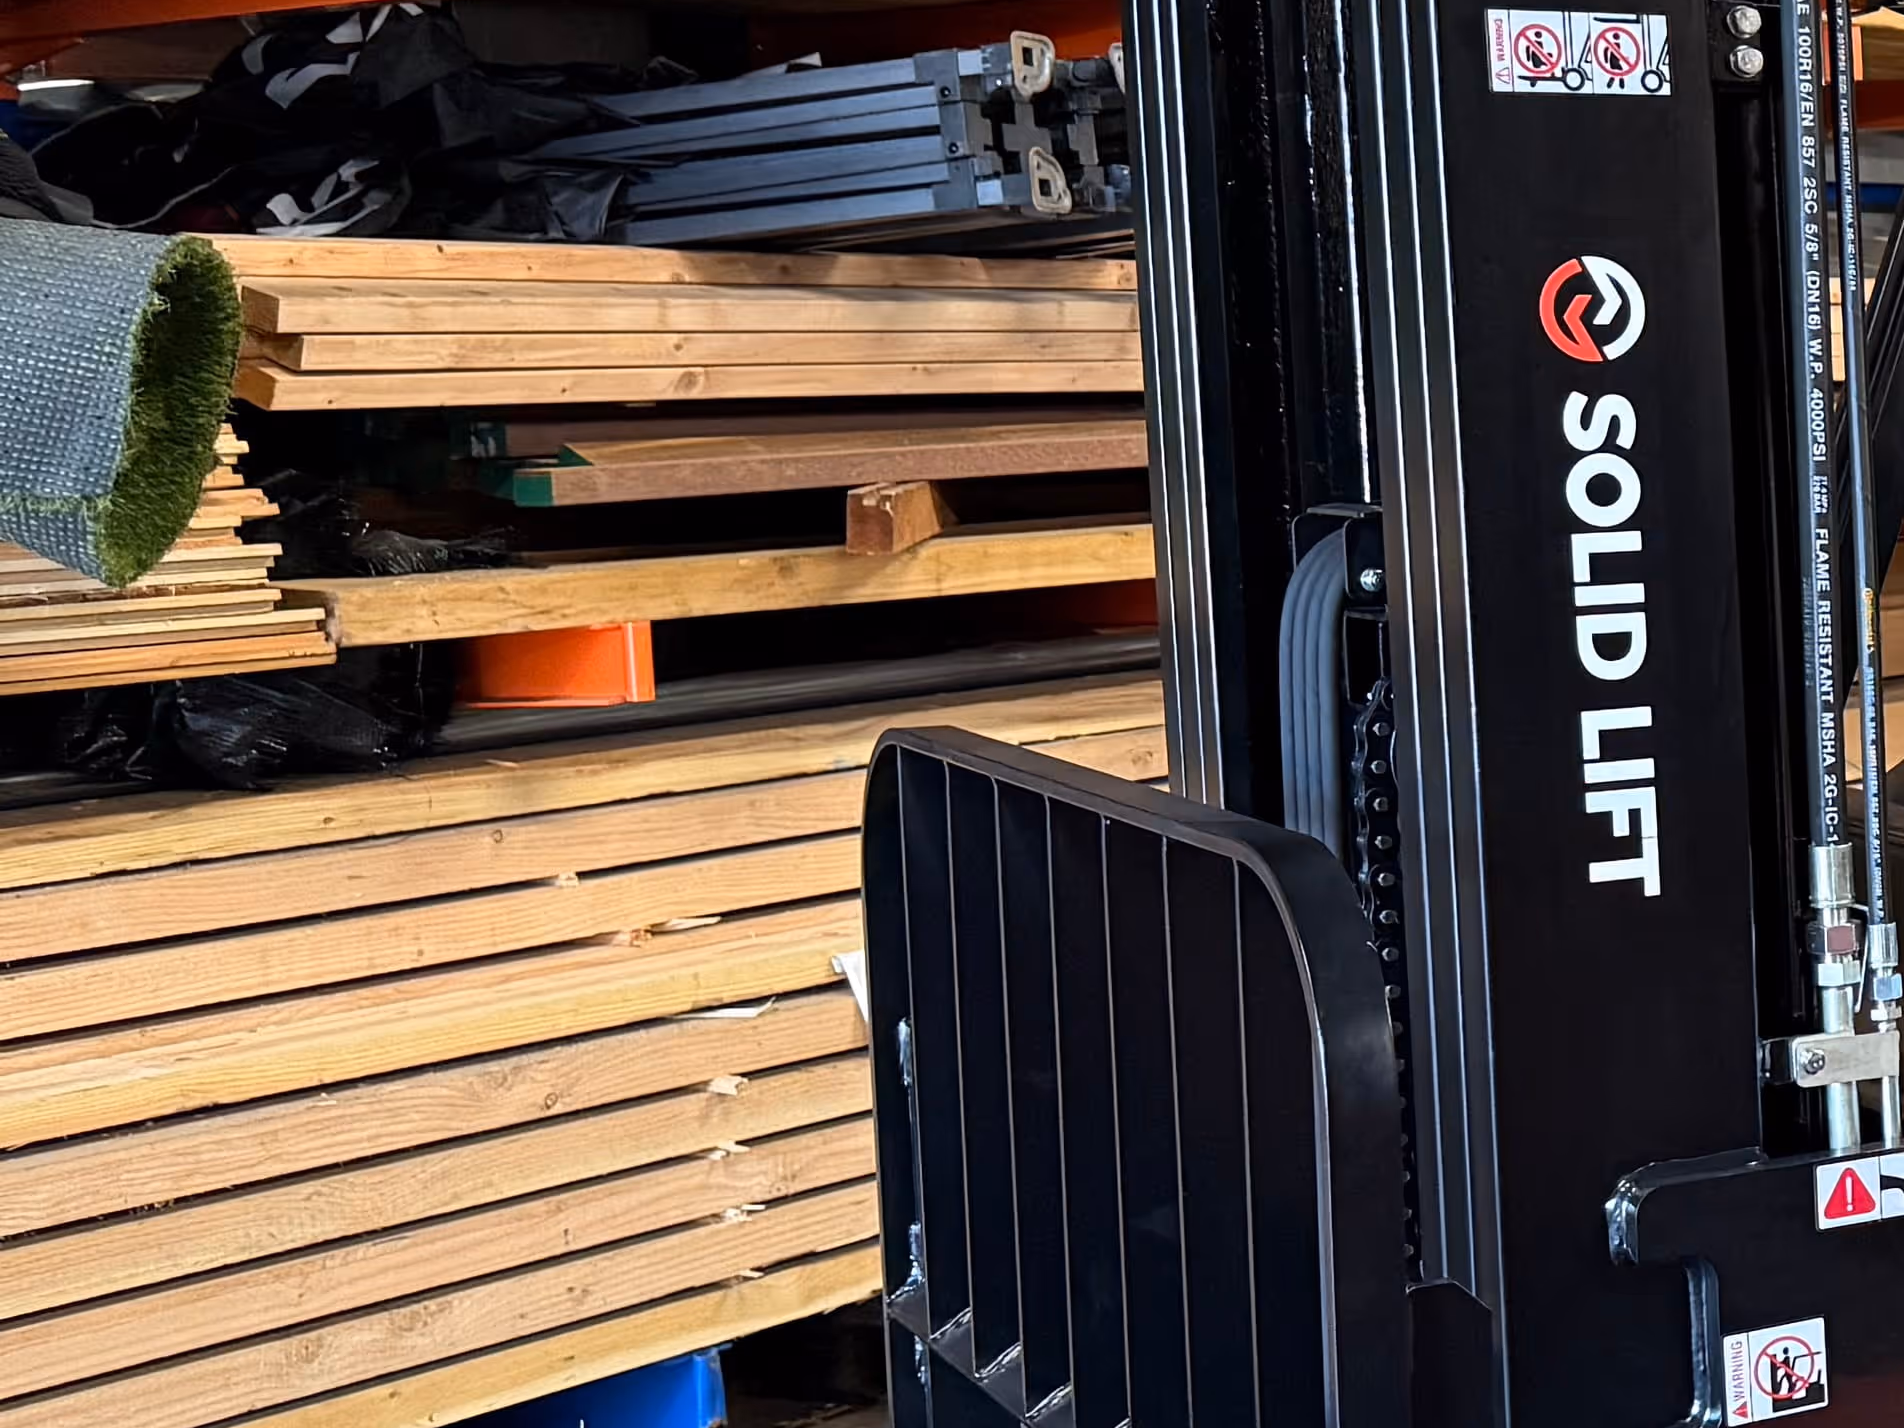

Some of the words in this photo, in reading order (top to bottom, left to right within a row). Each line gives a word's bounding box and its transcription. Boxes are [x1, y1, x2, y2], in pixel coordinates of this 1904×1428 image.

[1797, 25, 1816, 128] 100R16/EN
[1839, 98, 1850, 133] FLAME
[1800, 134, 1816, 168] 857
[1840, 135, 1852, 191] RESISTANT
[1801, 176, 1819, 215] 2SC
[1803, 222, 1820, 262] 5/8"
[1805, 269, 1824, 331] (DN16)
[1807, 337, 1825, 380] W.P.
[1809, 386, 1828, 462] 4000PSI
[1562, 390, 1650, 683] SOLID
[1814, 527, 1833, 593] FLAME
[1817, 600, 1835, 705] RESISTANT
[1821, 711, 1837, 767] MSHA
[1579, 705, 1662, 898] LIFT
[1823, 773, 1839, 845] 2G-IC-1
[1732, 1339, 1745, 1403] WARNING
